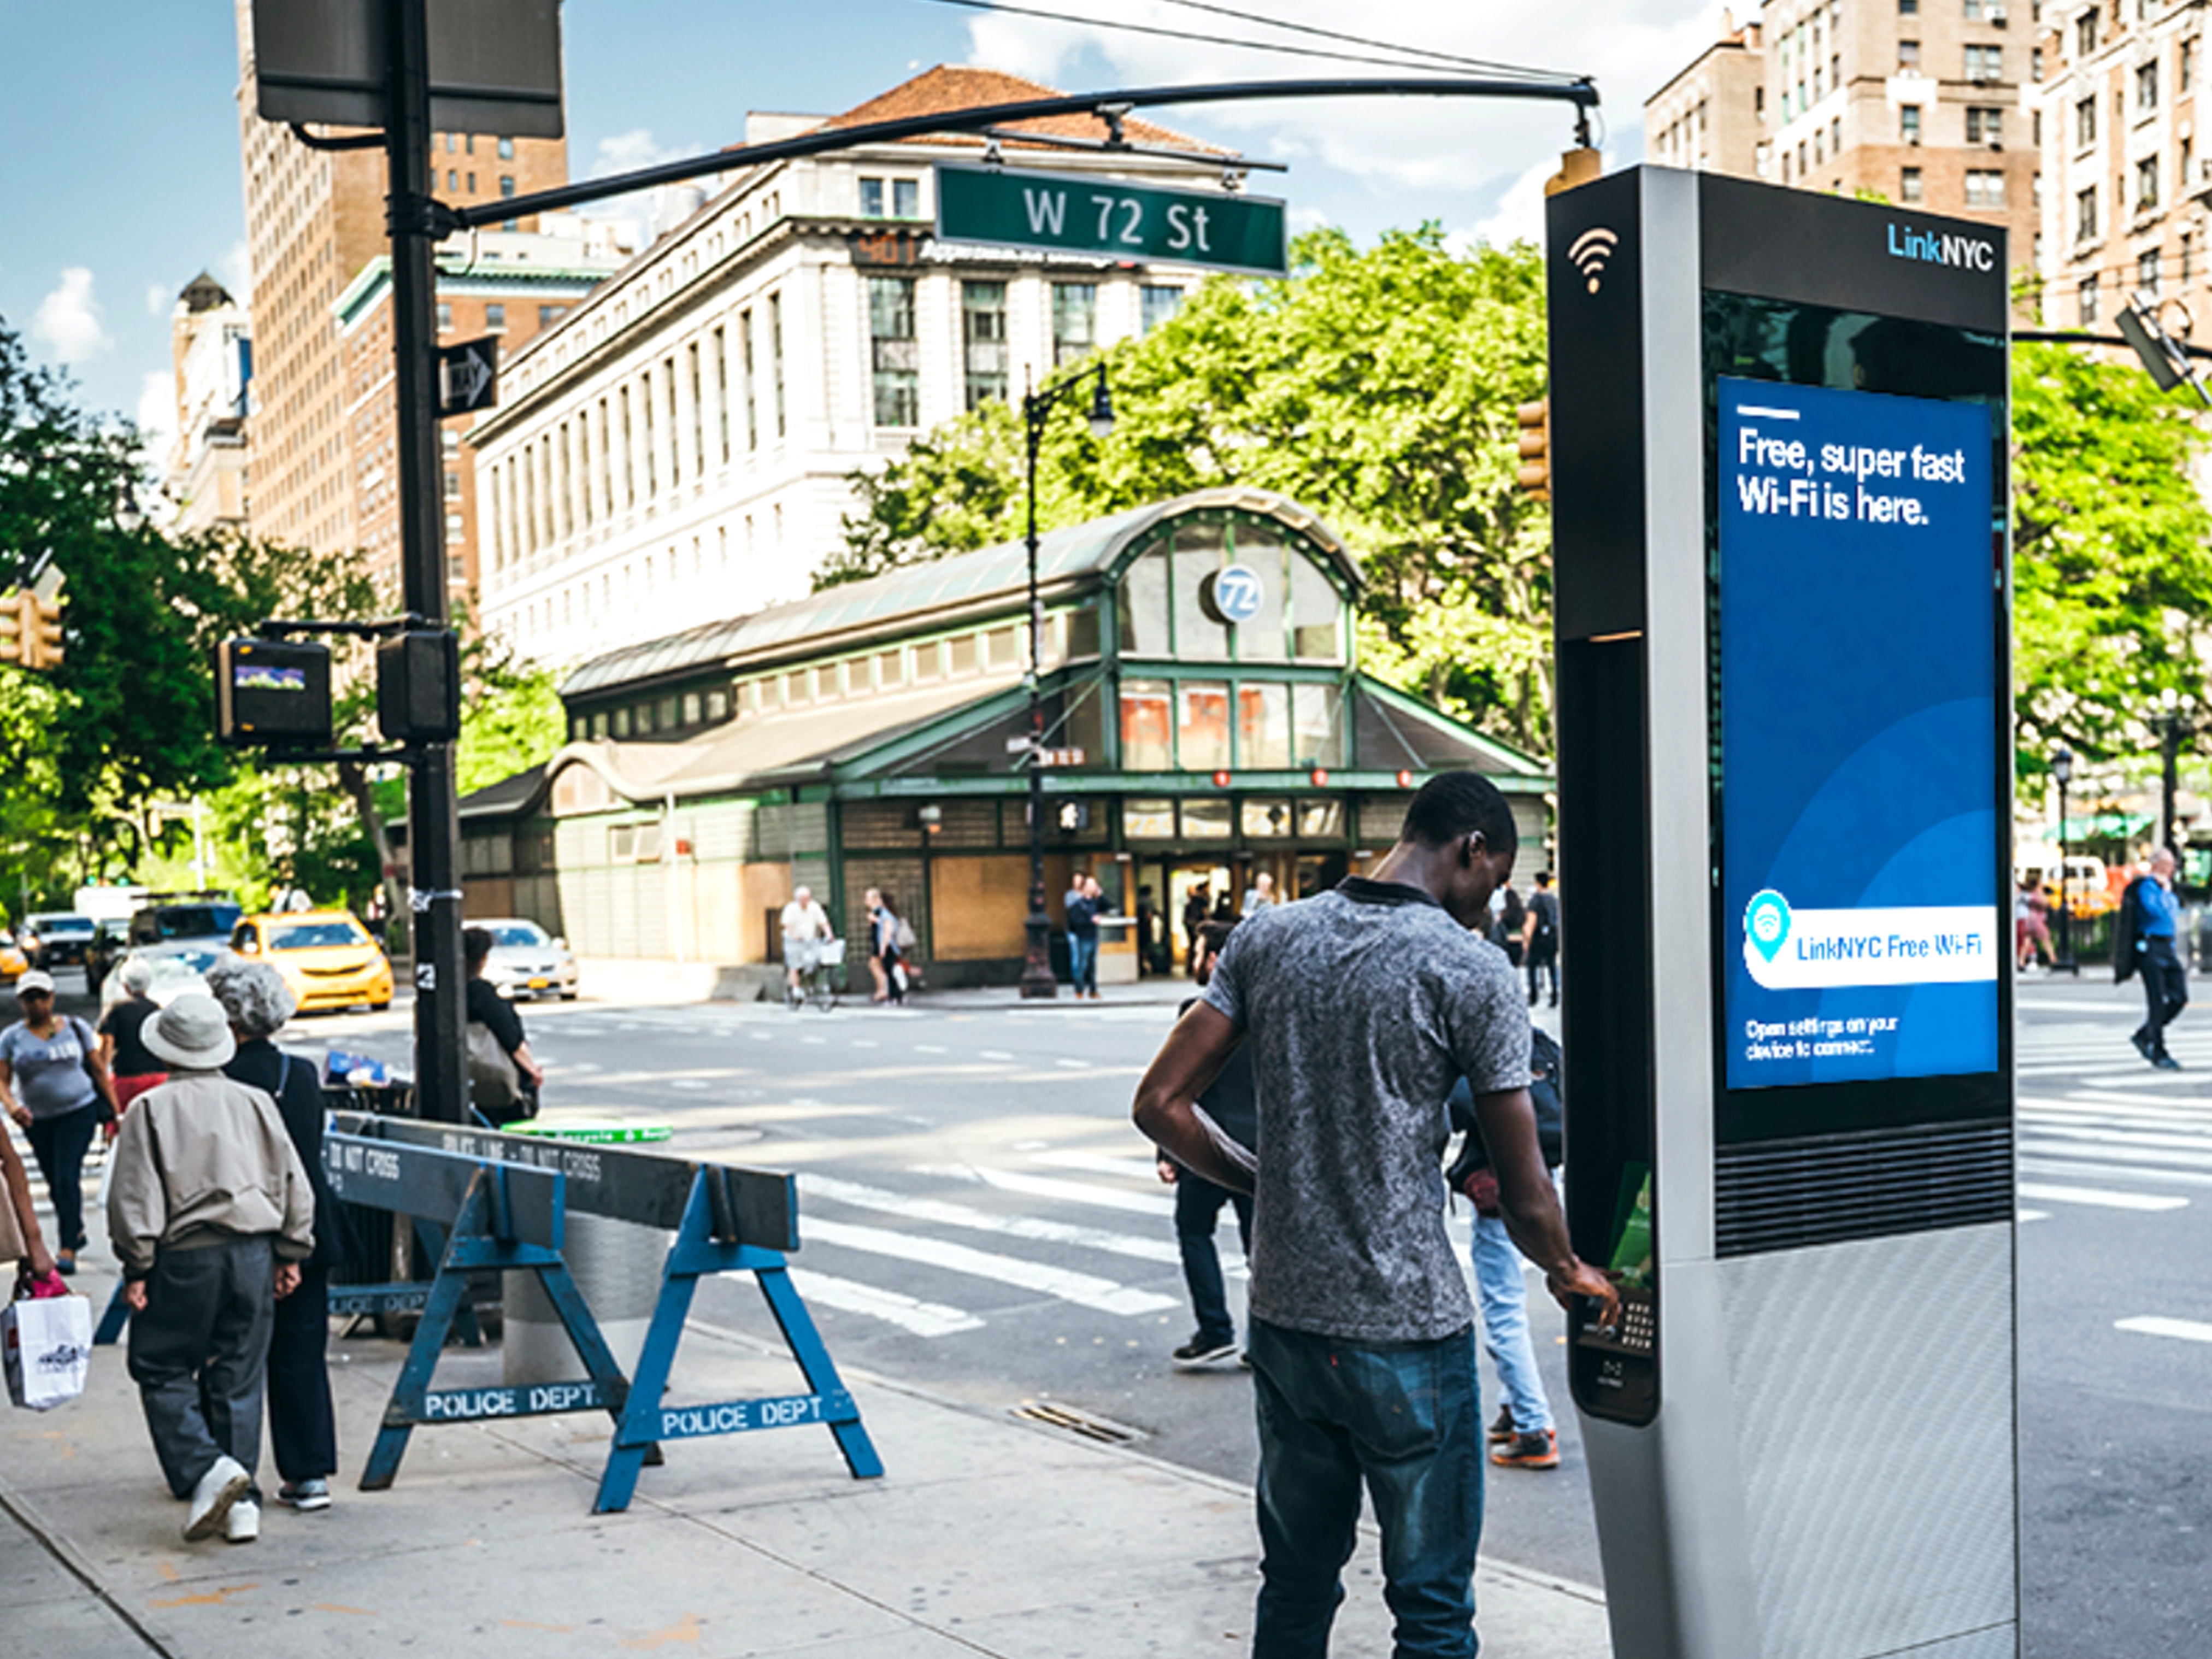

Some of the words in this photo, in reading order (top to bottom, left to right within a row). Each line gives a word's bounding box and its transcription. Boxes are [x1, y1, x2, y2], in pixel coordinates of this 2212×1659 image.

[1025, 189, 1067, 235] W
[1091, 195, 1143, 244] 72
[1167, 204, 1210, 252] St
[1887, 223, 1995, 272] LinkNYC
[1740, 427, 1814, 477] Free,
[1821, 443, 1907, 484] super
[1911, 444, 1965, 484] fast
[1738, 474, 1818, 517] Wi-Fi
[1824, 481, 1849, 520] is
[1857, 484, 1929, 526] here.
[1223, 576, 1256, 610] 72
[1797, 936, 1883, 961] LinkNYC
[1888, 934, 1930, 958] Free
[1934, 932, 1982, 956] Wi-Fi
[1745, 1019, 1786, 1042] Open
[1846, 1017, 1866, 1033] on
[1868, 1017, 1899, 1036] your
[330, 1142, 342, 1169] DO
[345, 1145, 364, 1173] NOT
[365, 1148, 400, 1180] CROSS
[562, 1150, 601, 1183] CROSS
[384, 1293, 425, 1313] DEP
[425, 1390, 517, 1417] POLICE
[662, 1404, 748, 1436] POLICE
[761, 1396, 822, 1425] DEPT
